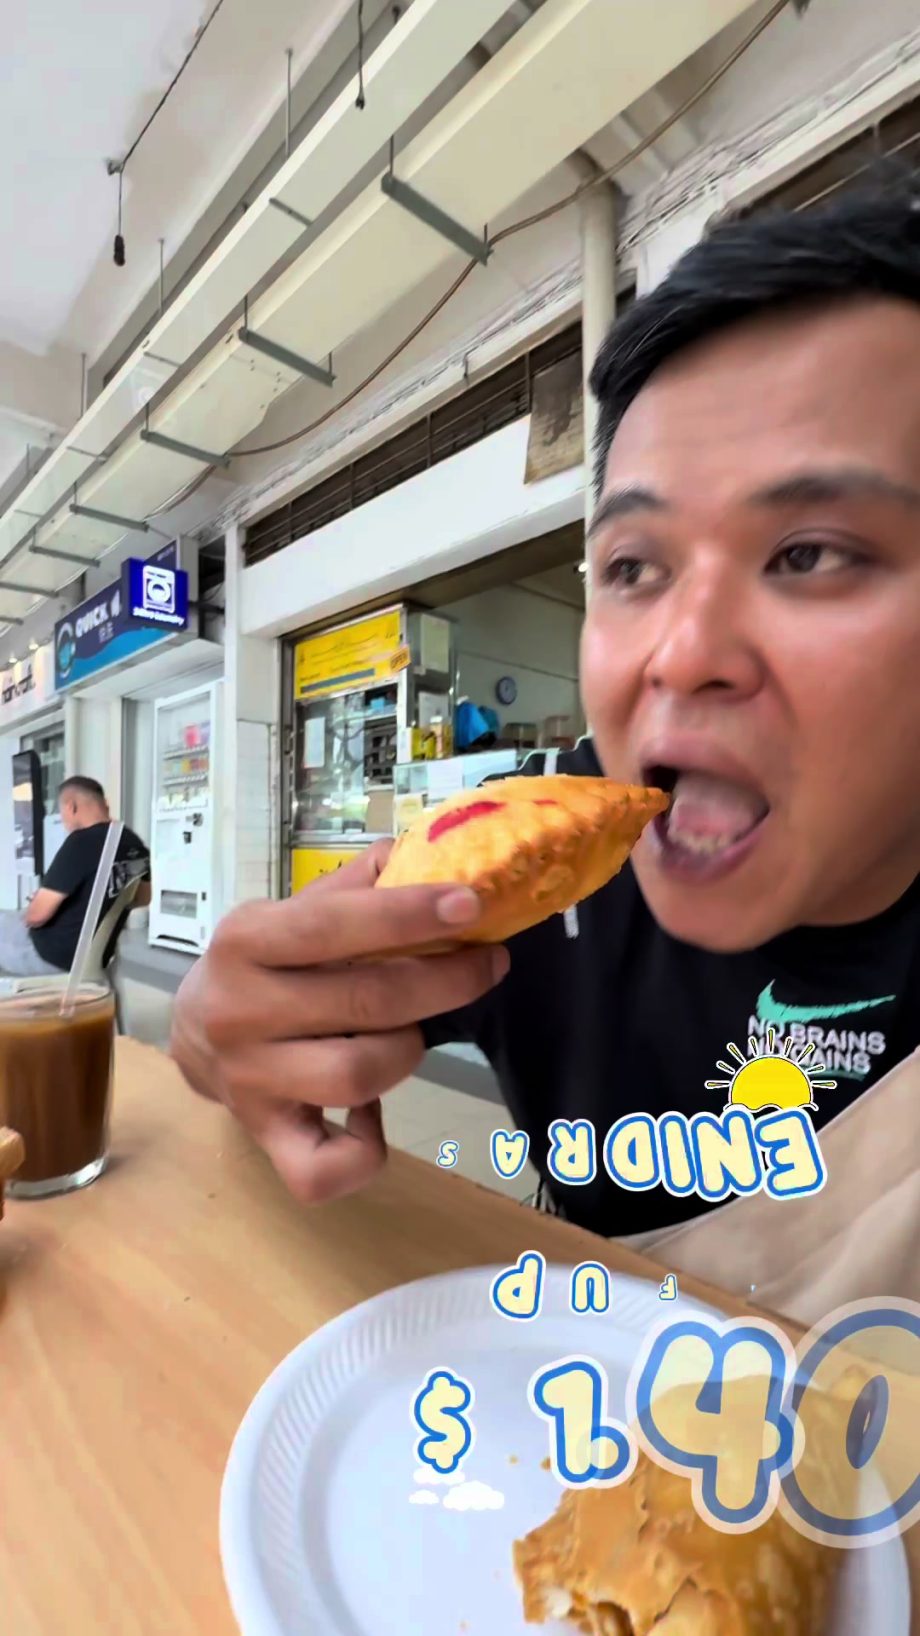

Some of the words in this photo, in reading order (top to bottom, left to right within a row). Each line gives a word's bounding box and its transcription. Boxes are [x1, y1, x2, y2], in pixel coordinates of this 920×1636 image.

[75, 601, 109, 638] QUICK
[747, 1014, 785, 1038] NO
[789, 1021, 886, 1056] BRAINS
[790, 1044, 872, 1075] GAINS
